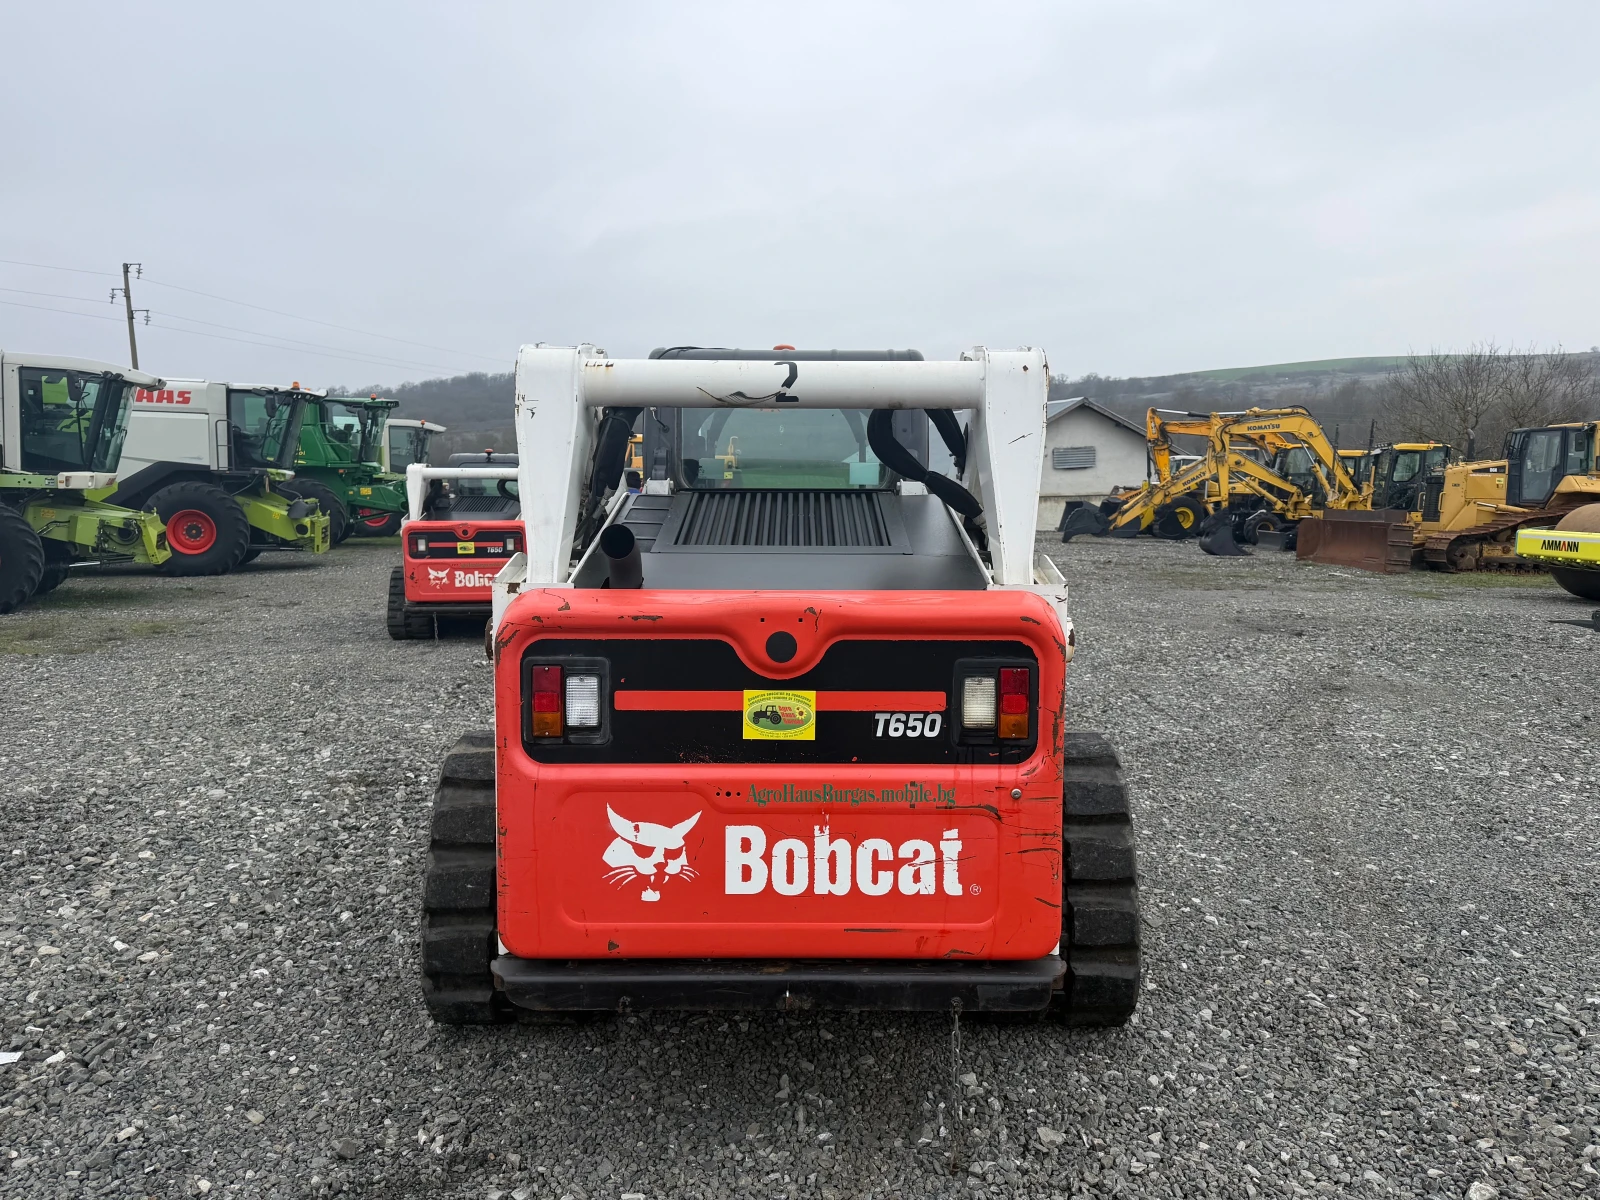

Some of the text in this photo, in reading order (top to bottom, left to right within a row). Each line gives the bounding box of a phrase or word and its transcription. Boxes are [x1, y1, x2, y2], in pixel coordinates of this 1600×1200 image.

[135, 389, 192, 405] AAS
[1247, 423, 1280, 431] KOMATSU
[1182, 471, 1206, 486] KOMATS
[1541, 539, 1580, 553] AMMANN
[454, 571, 498, 587] Bobc
[874, 713, 942, 738] T650
[746, 783, 956, 807] AgroHausBurgas.mobile.bg
[725, 825, 963, 896] Bobcat
